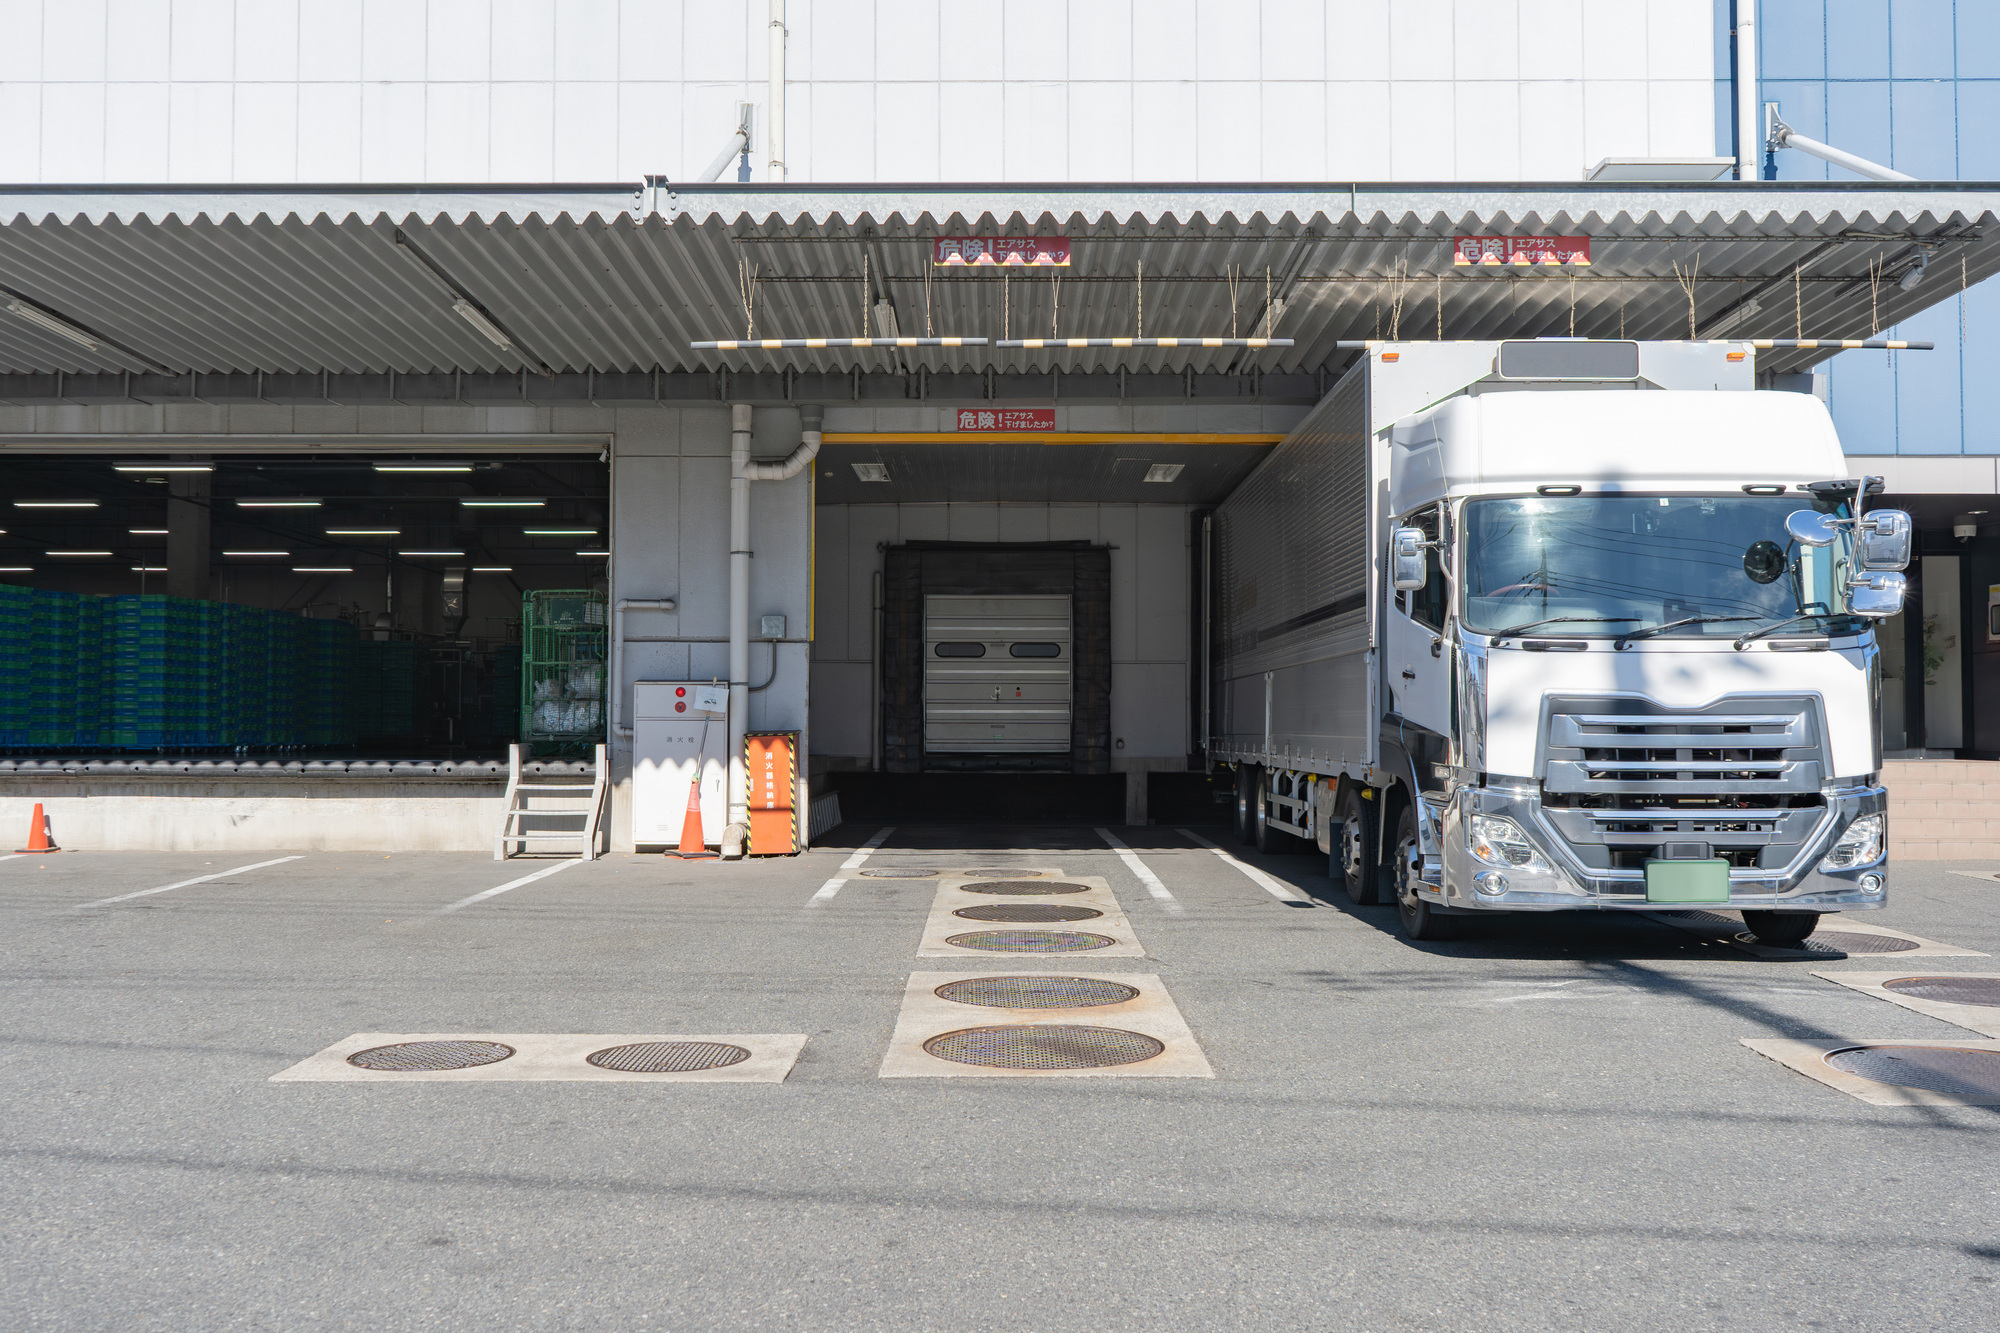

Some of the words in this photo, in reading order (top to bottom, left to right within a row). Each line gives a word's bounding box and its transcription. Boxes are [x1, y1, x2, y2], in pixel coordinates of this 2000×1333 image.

[996, 239, 1036, 248] エアサス
[1516, 239, 1556, 248] エアサス
[938, 239, 993, 261] 危険!
[1458, 238, 1513, 261] 危険!
[959, 411, 1003, 429] 危険!
[1004, 412, 1034, 420] エアサス
[1004, 421, 1054, 429] 下げましたか?
